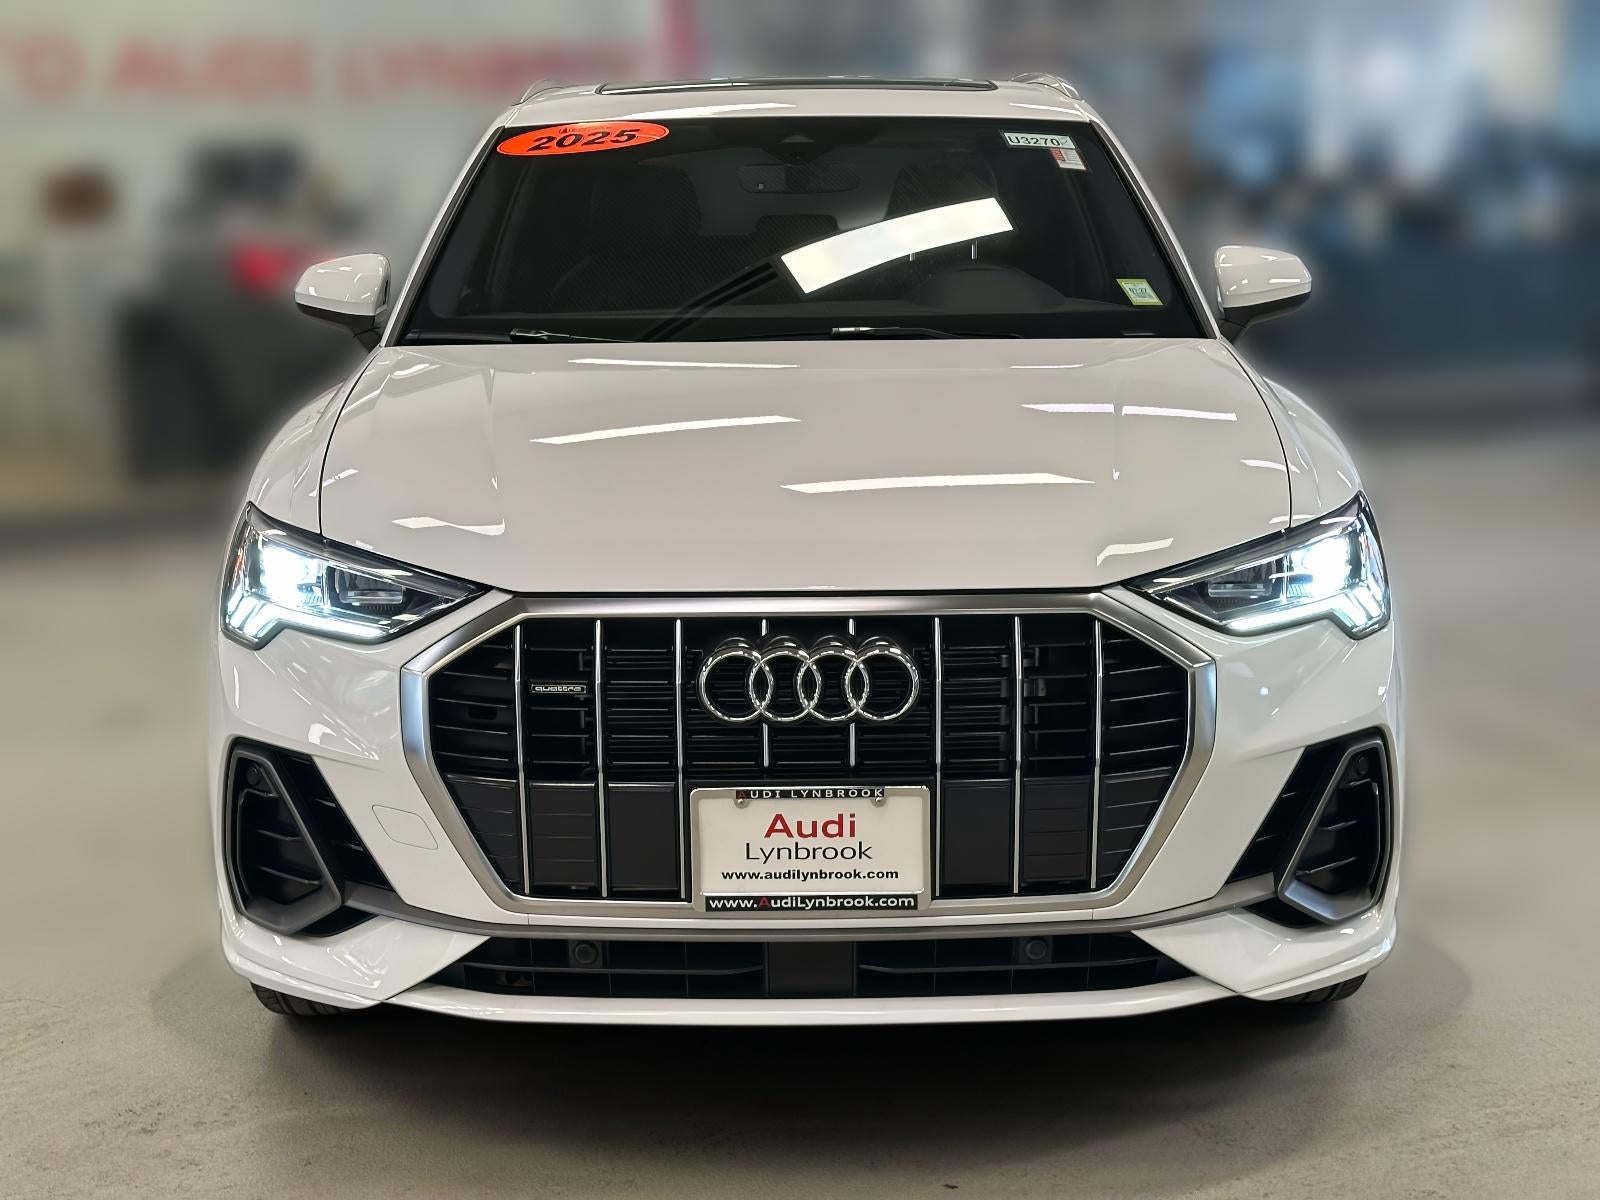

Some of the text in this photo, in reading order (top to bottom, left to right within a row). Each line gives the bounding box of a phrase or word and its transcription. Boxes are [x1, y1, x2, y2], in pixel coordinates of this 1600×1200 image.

[527, 129, 640, 152] 2025
[1007, 136, 1060, 146] U3270
[737, 788, 884, 799] AUDI LYNBROOK
[764, 813, 856, 839] Audi
[746, 841, 873, 864] Lynbrook
[721, 869, 899, 882] www.audilynbrook.com
[709, 896, 915, 909] www.AudiLynbrook.com
